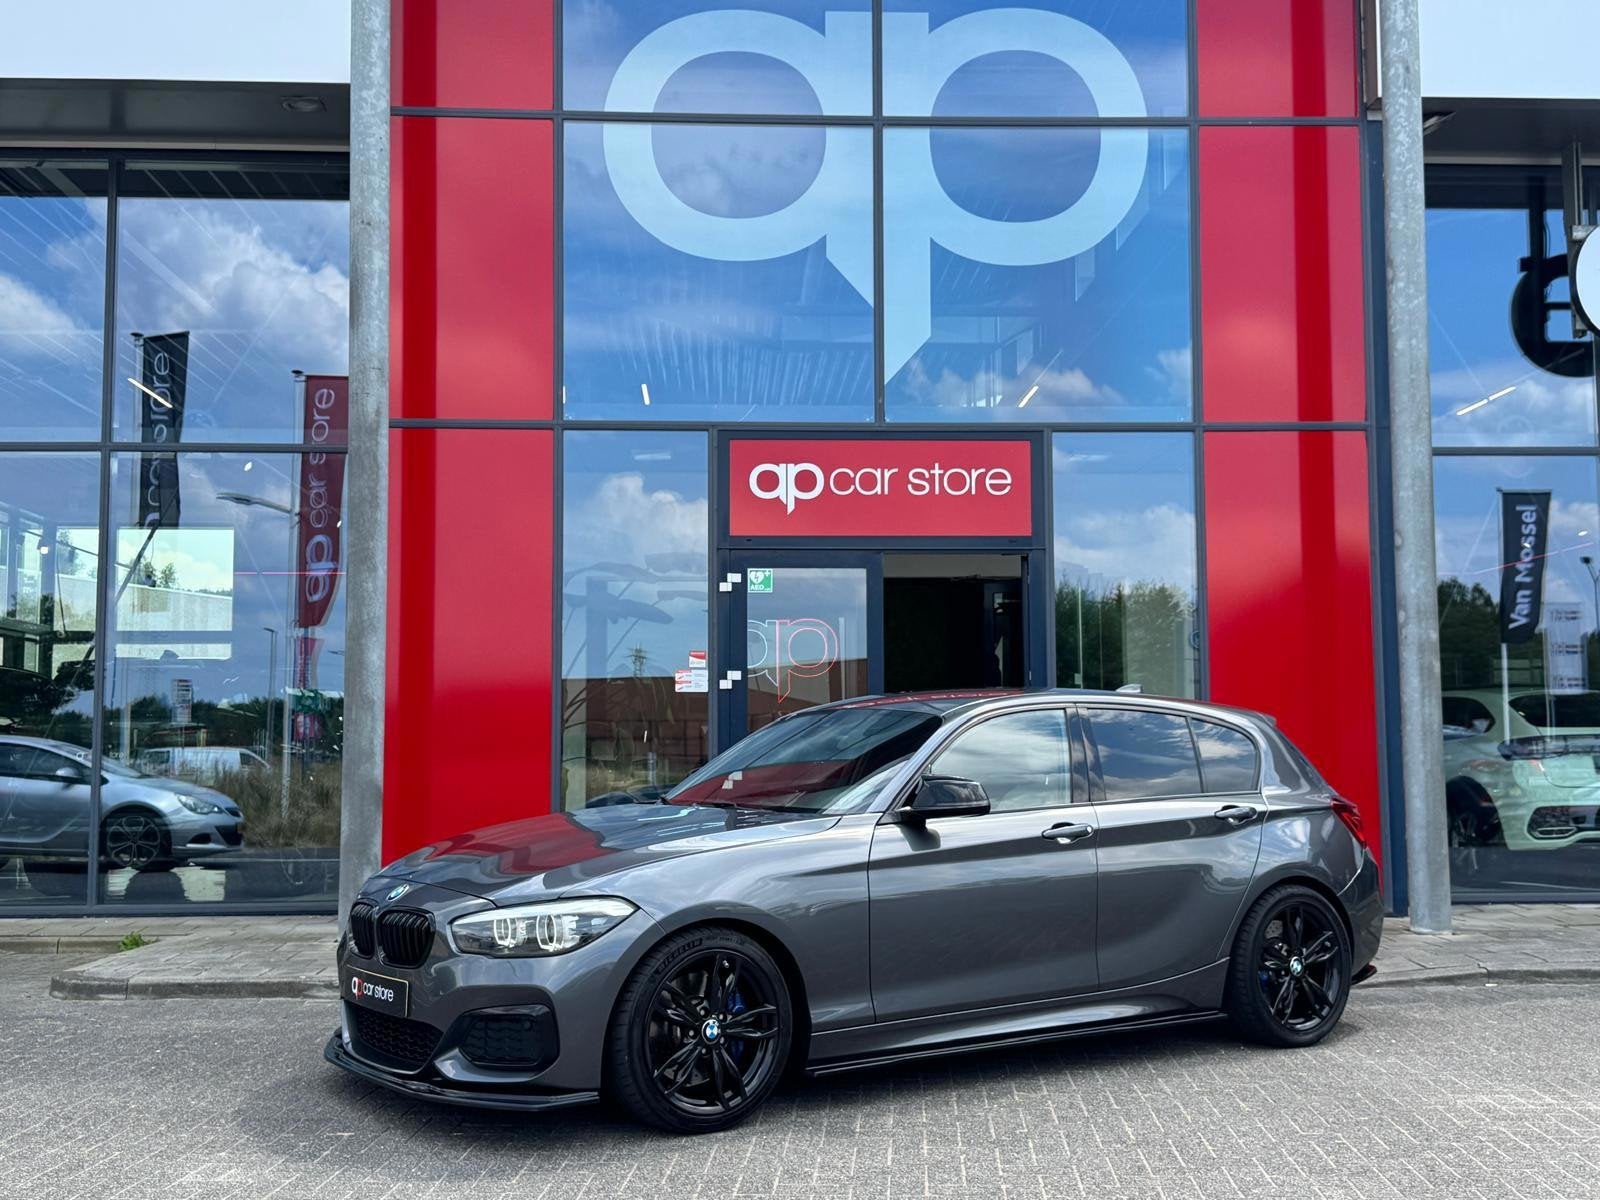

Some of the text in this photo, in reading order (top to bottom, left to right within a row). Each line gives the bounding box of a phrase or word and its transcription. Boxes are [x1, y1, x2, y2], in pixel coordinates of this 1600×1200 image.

[603, 8, 1148, 385] ap
[310, 388, 336, 465] sore
[309, 473, 328, 528] car
[749, 462, 1013, 515] ap car store
[1508, 504, 1538, 630] Van Mossel
[363, 982, 375, 996] car
[374, 985, 394, 1002] store
